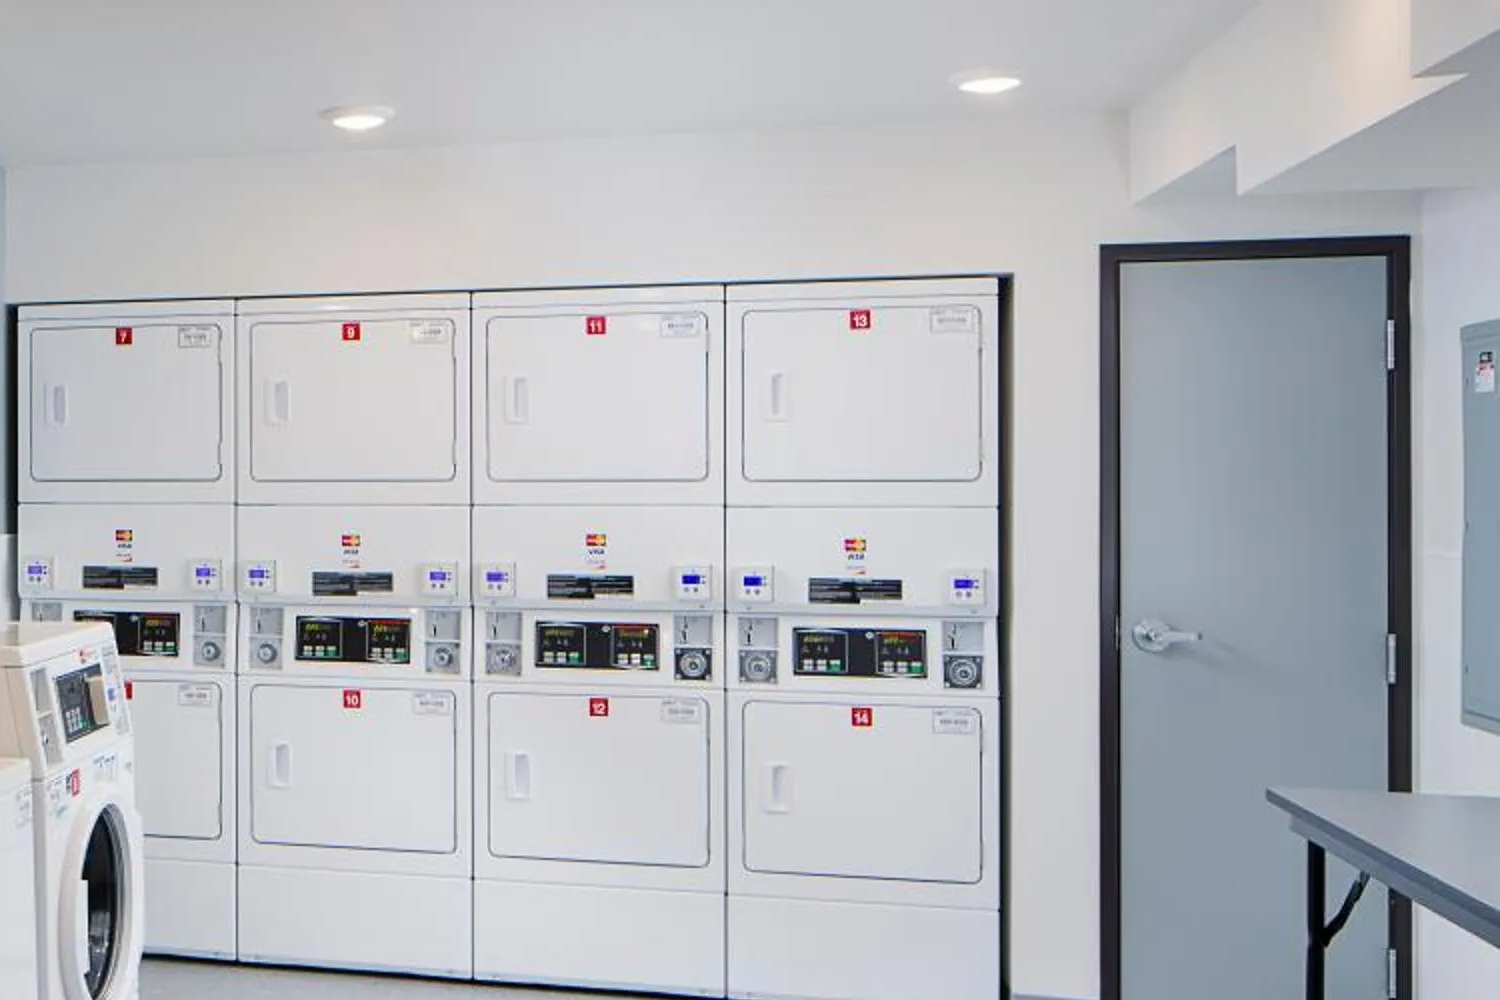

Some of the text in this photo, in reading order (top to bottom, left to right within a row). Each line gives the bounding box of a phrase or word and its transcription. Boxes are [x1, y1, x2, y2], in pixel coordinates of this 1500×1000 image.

[589, 319, 603, 332] 11
[854, 314, 869, 327] 13
[120, 330, 127, 343] 7
[346, 327, 355, 339] 9
[346, 694, 359, 706] 10
[592, 703, 606, 715] 12
